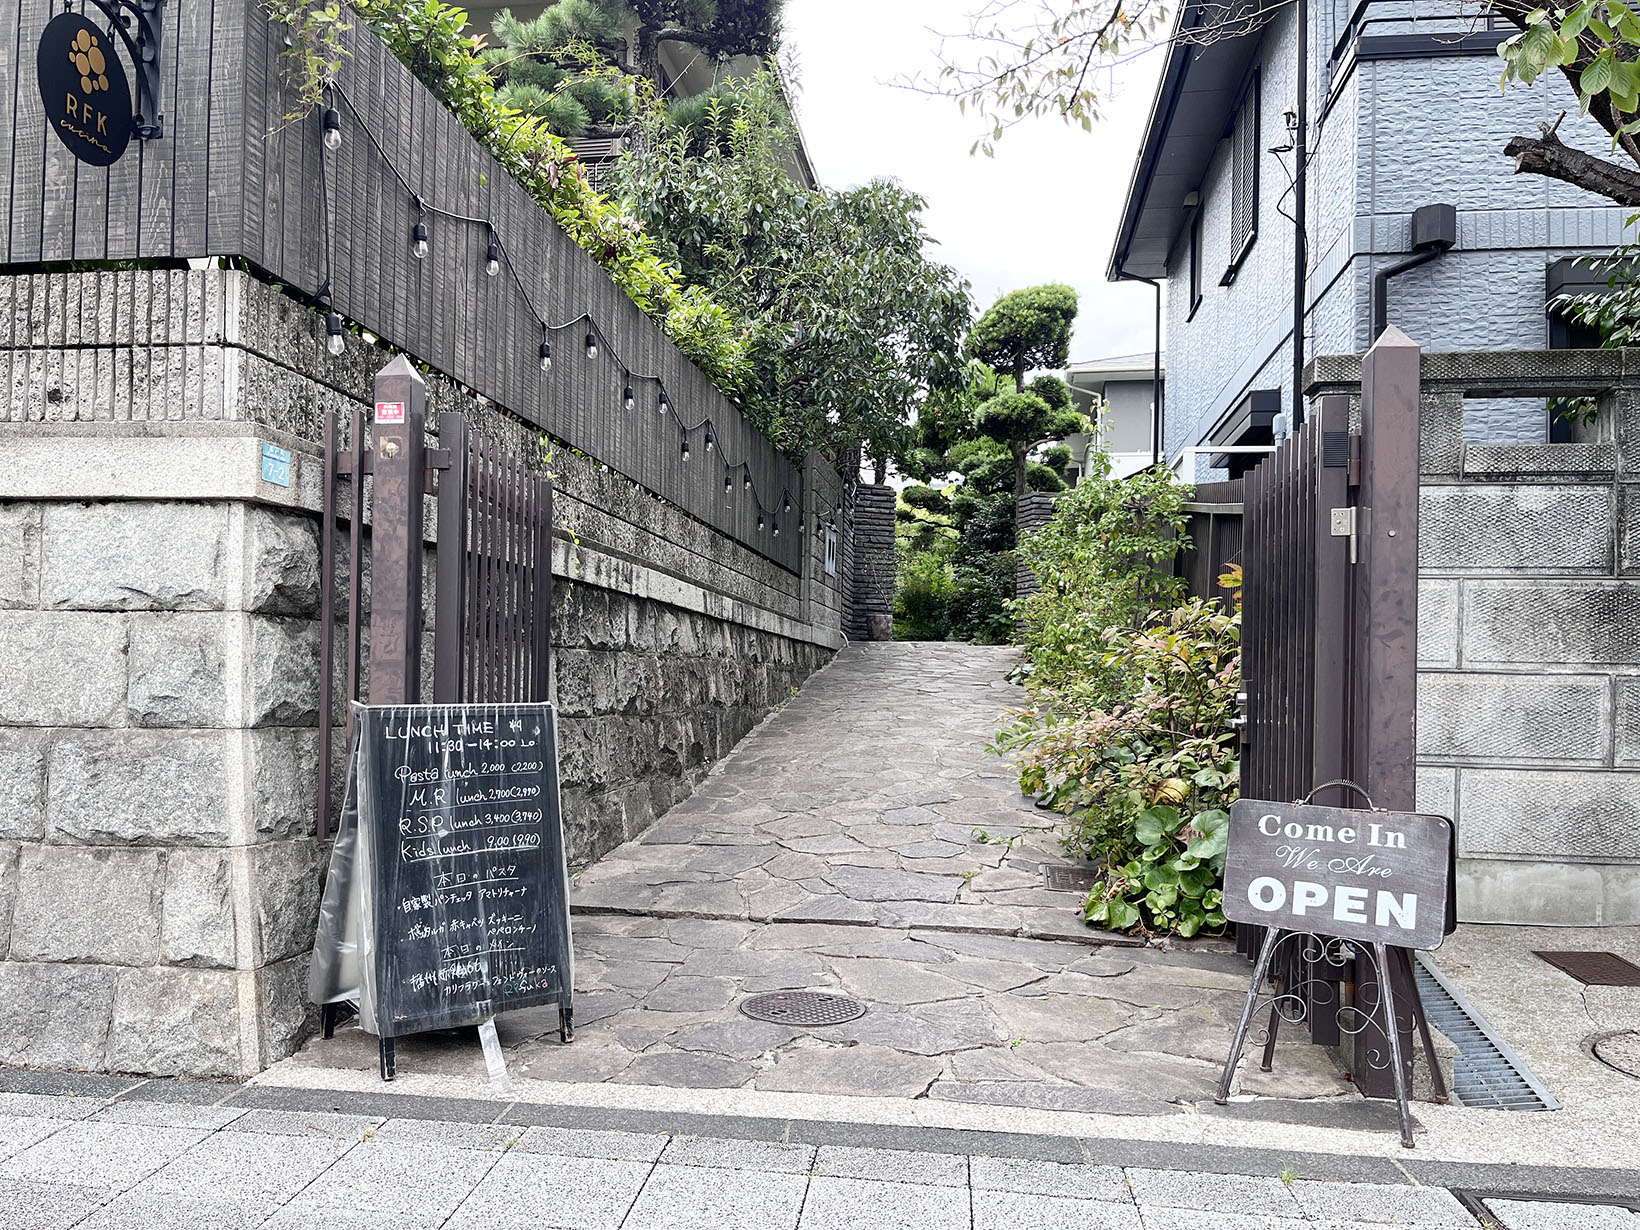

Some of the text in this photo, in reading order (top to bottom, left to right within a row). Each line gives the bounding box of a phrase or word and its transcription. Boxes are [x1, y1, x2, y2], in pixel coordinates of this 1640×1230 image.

[66, 92, 107, 136] RFK
[268, 463, 285, 481] 7-2
[385, 723, 446, 739] LUNCH
[453, 721, 494, 736] TIME
[394, 761, 544, 784] Pasta lunch 2,000 (2,200)
[456, 788, 487, 804] lunch
[450, 815, 482, 831] lunch
[1258, 814, 1407, 849] Come In
[401, 840, 434, 863] Kids
[437, 839, 471, 856] lunch
[1275, 845, 1393, 879] We Are
[478, 886, 528, 901] アマトリチャーナ
[1248, 876, 1418, 930] OPEN
